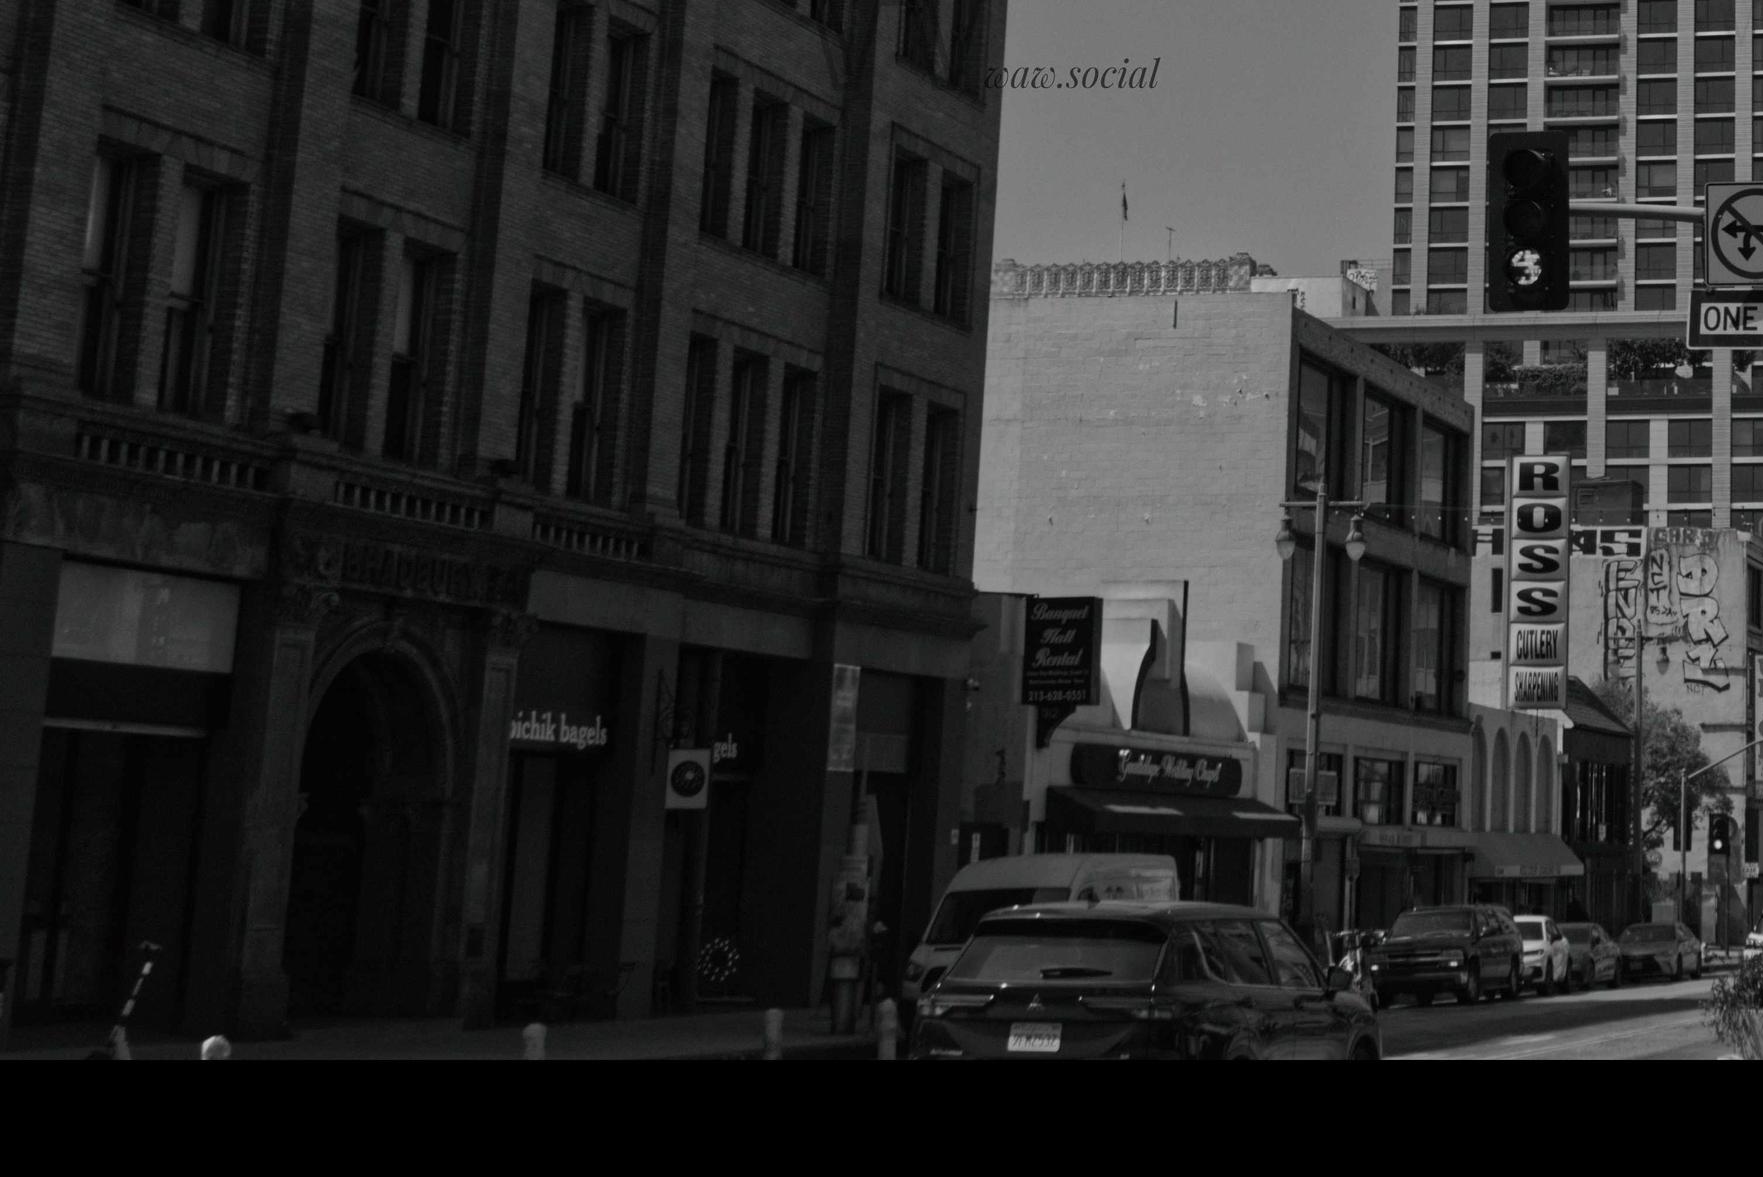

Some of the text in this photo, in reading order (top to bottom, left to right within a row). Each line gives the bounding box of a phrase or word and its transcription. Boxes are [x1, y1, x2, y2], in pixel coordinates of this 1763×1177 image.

[1704, 307, 1758, 331] ONE
[1517, 461, 1562, 617] ROSS
[1031, 603, 1090, 624] Banquet
[1040, 627, 1077, 644] Hall
[1516, 630, 1559, 659] CUTLERY
[1032, 648, 1084, 669] Rental
[1514, 672, 1559, 703] SHARPENING
[559, 713, 608, 750] bagels
[713, 732, 738, 763] gels
